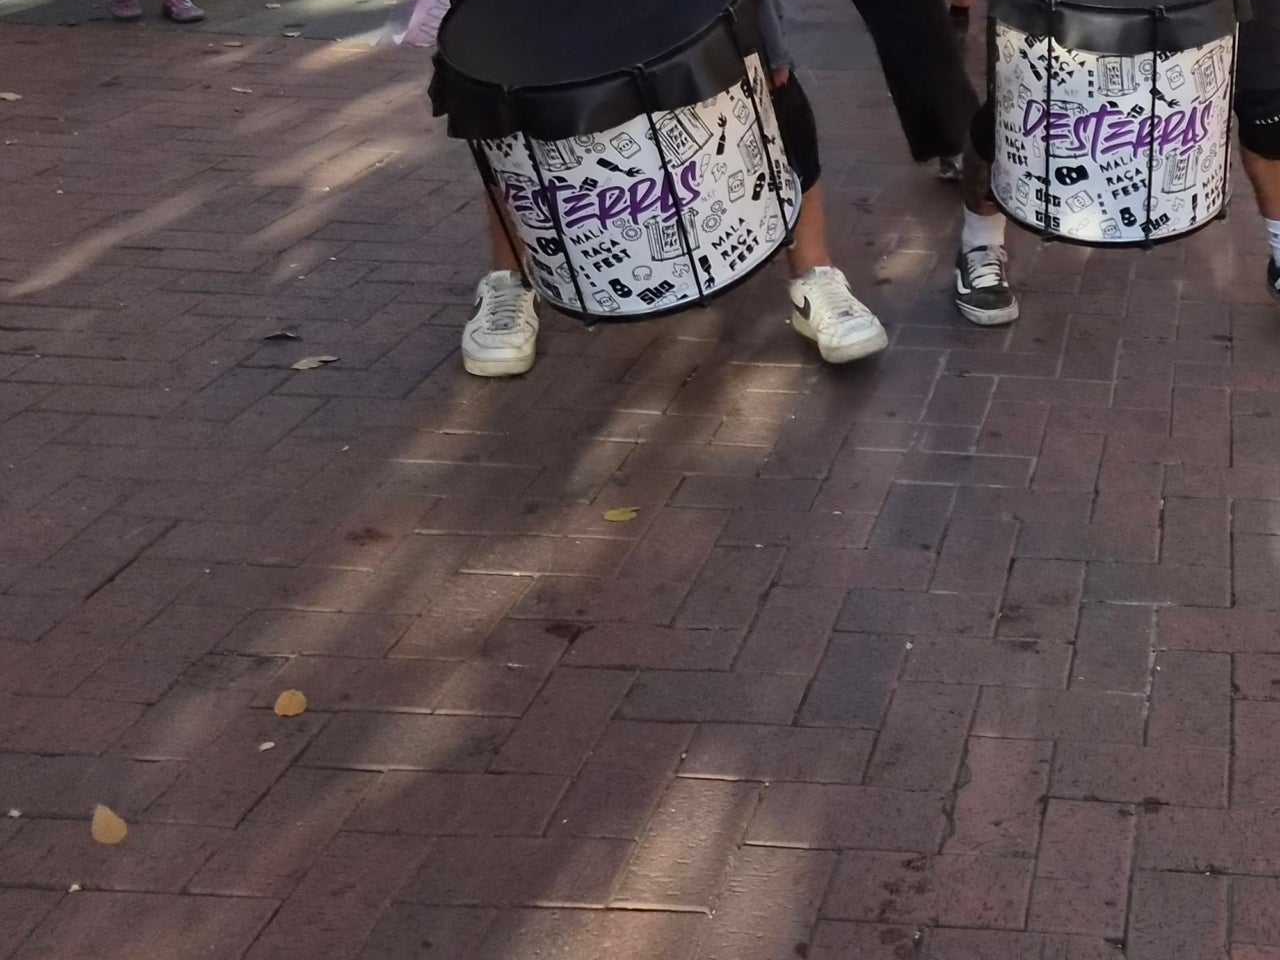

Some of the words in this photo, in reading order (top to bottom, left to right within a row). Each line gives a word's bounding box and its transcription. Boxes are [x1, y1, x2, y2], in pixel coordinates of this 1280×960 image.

[1007, 150, 1029, 167] FEST
[1105, 167, 1144, 186] RAÇA
[1111, 177, 1149, 200] FEST
[711, 217, 748, 250] MALA
[720, 228, 754, 261] RAÇA
[581, 239, 621, 260] RAÇA
[592, 248, 632, 273] FEST
[728, 238, 760, 272] FEST
